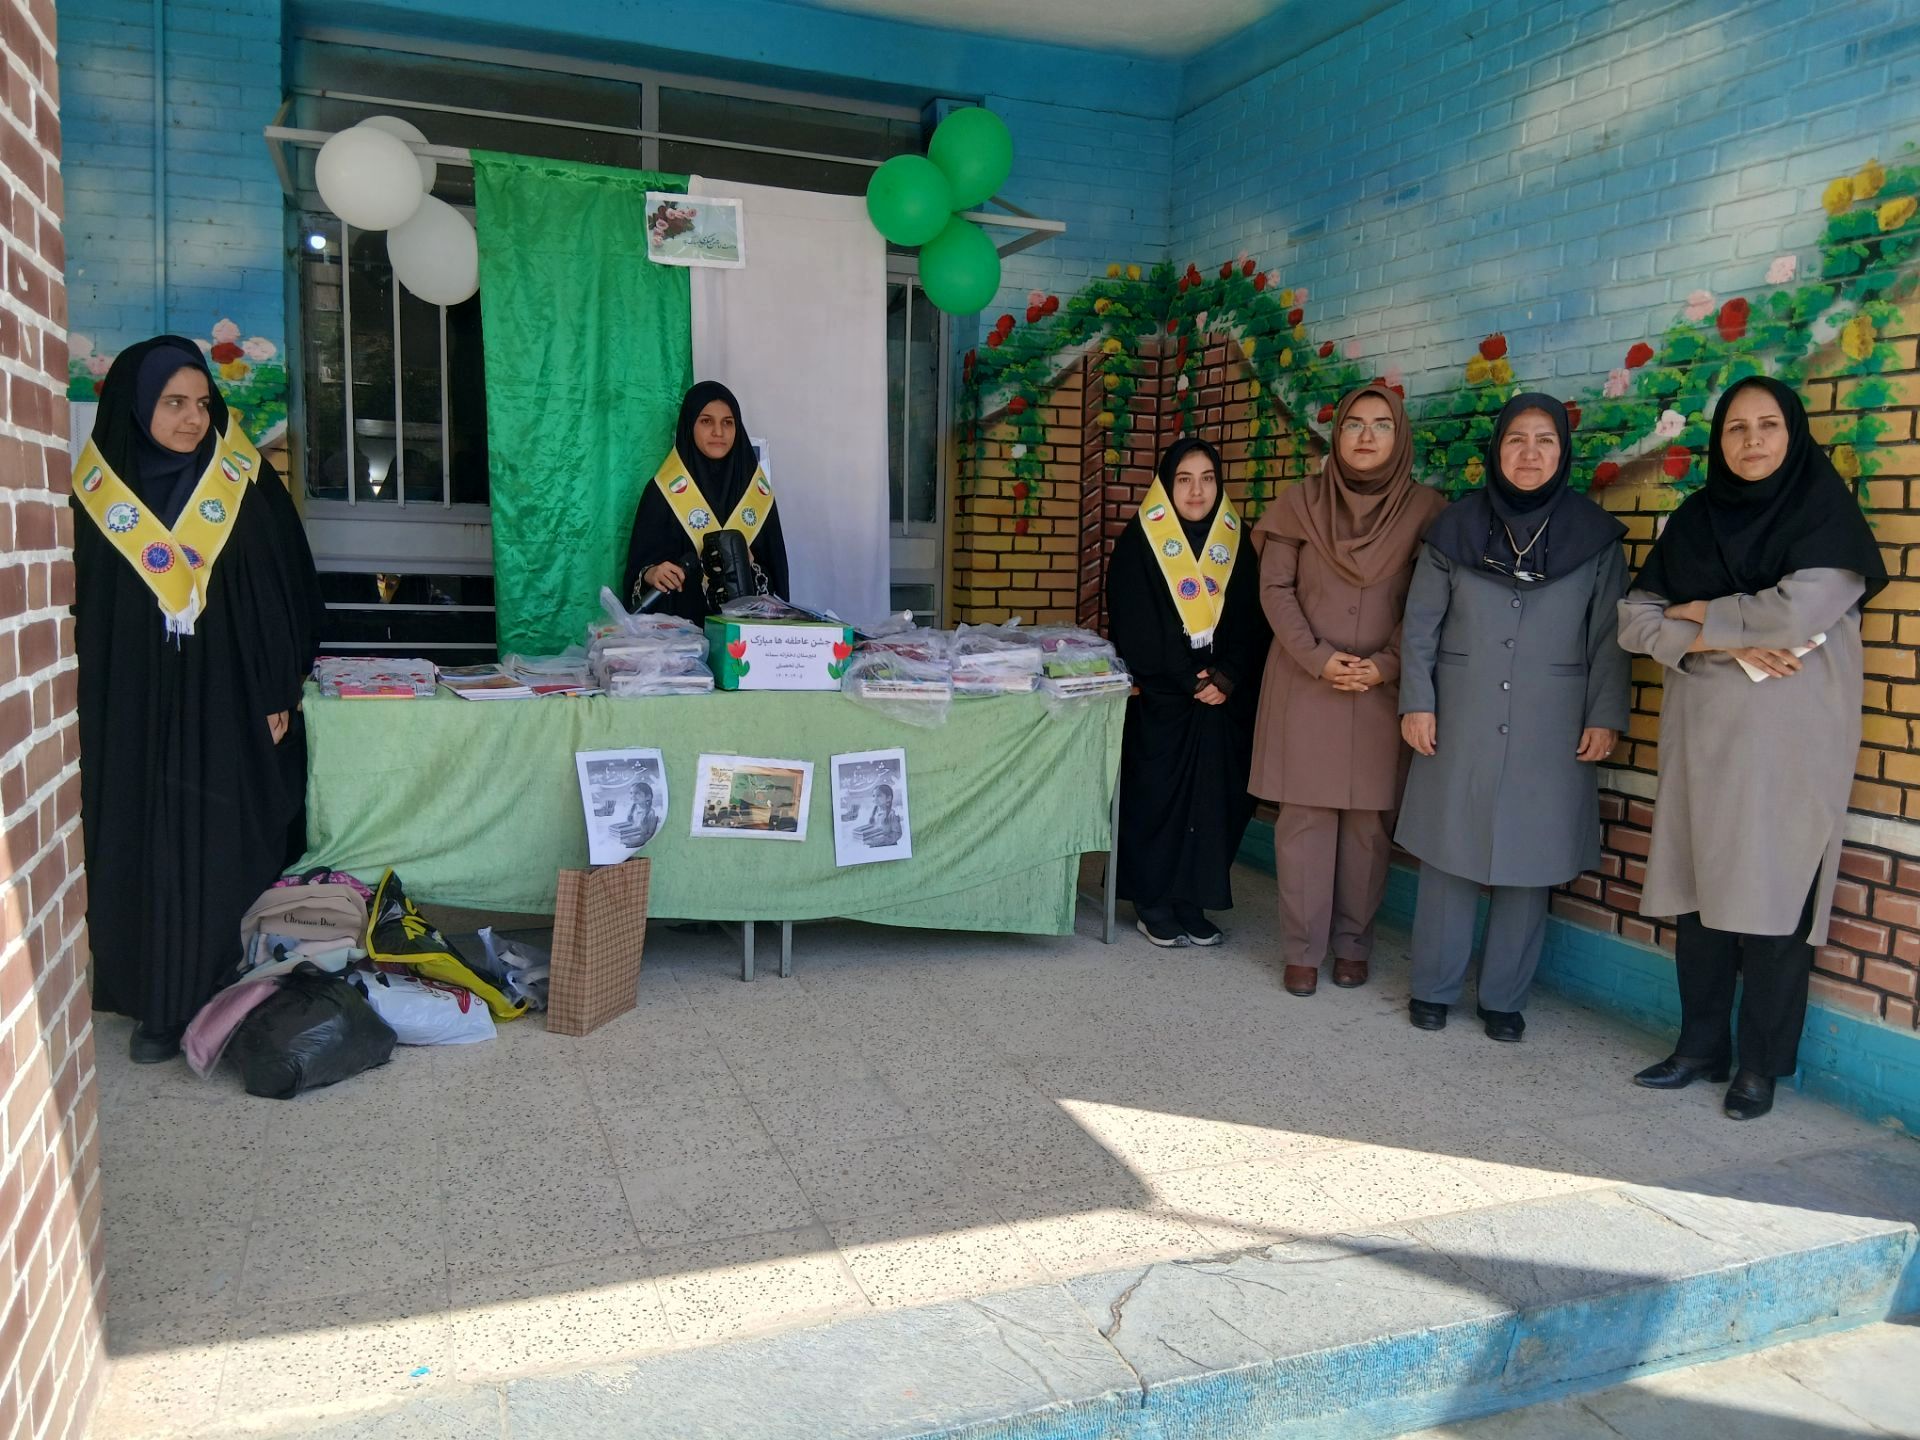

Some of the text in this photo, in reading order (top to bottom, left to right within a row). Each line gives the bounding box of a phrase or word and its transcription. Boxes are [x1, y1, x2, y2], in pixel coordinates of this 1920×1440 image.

[750, 635, 832, 648] جشن عاطفه ها مبارک
